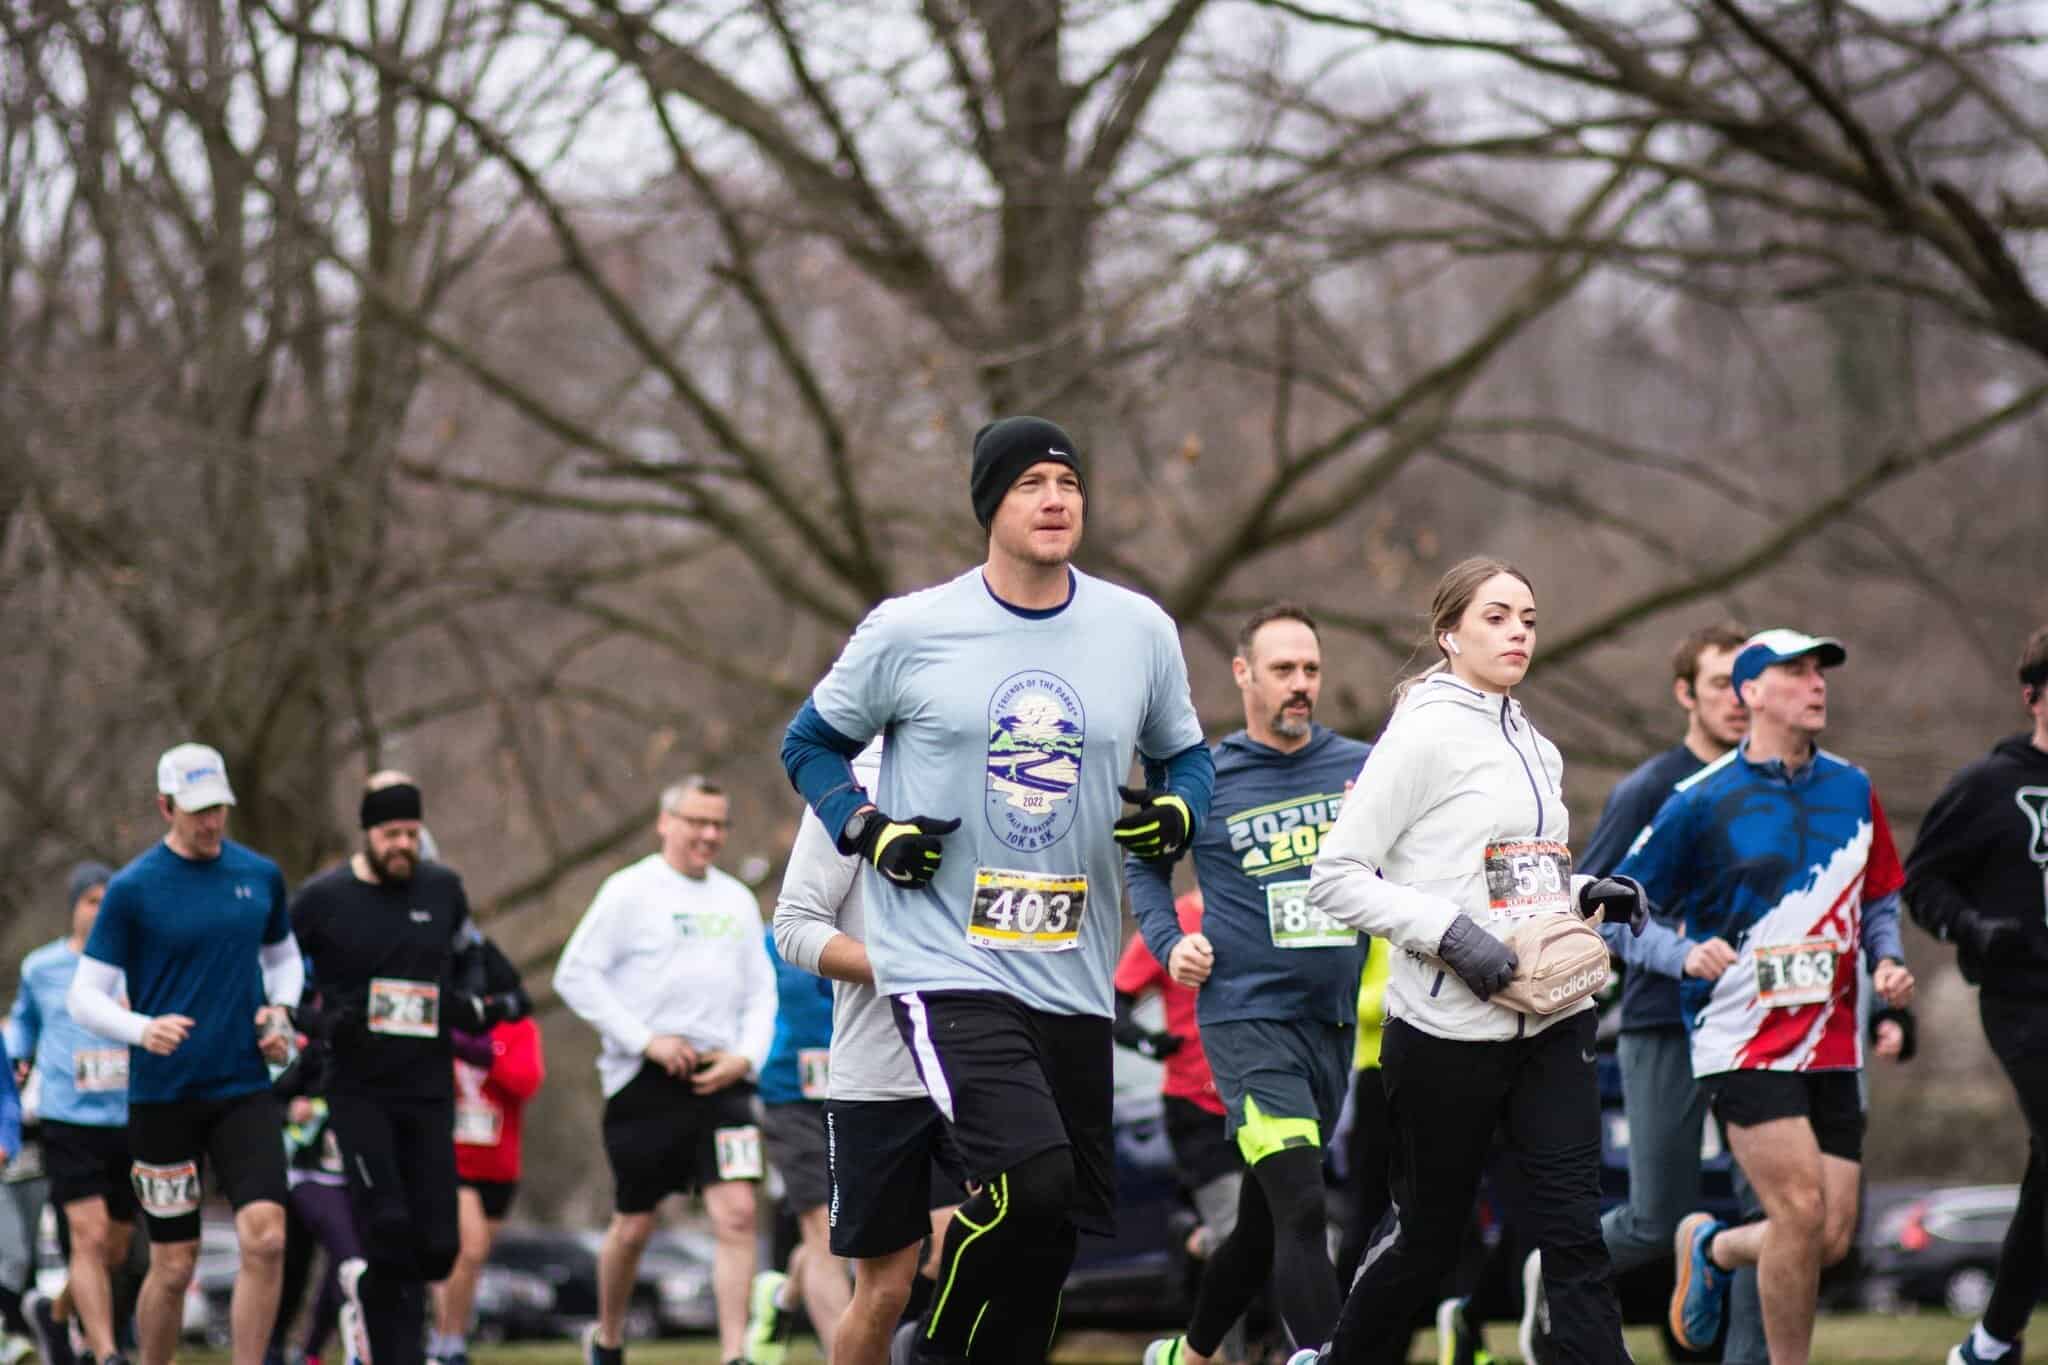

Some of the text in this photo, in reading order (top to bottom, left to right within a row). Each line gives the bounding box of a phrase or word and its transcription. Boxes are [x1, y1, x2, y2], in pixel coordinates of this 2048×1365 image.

[998, 679, 1075, 713] FRIENDS OF THE PARKS
[1023, 796, 1044, 808] 2022
[1006, 829, 1055, 849] 10K & 5K
[1512, 855, 1561, 897] 59
[986, 889, 1072, 934] 403
[1550, 965, 1605, 1003] adidas
[1768, 951, 1835, 989] 163
